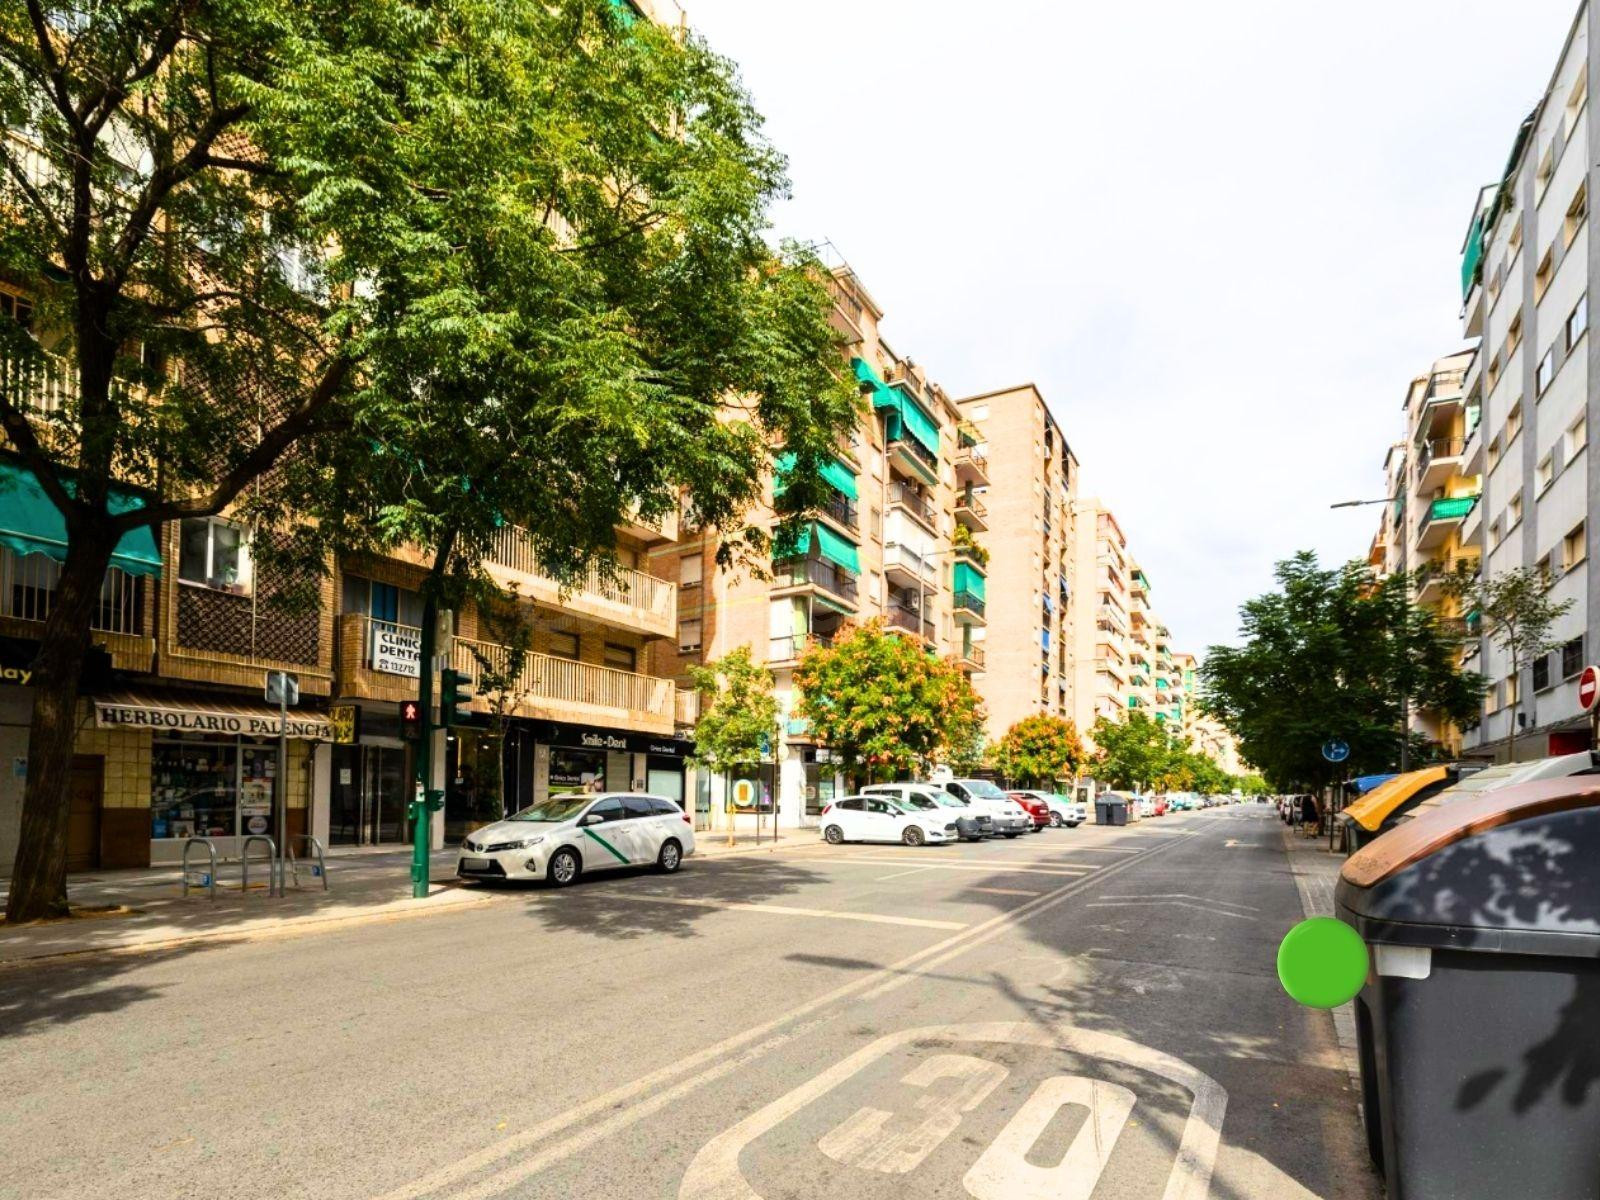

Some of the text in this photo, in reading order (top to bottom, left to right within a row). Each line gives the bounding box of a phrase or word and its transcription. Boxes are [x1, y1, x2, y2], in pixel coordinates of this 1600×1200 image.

[380, 644, 420, 661] DENTA
[381, 633, 420, 650] CLINIC
[101, 707, 241, 732] HERBOLARIO
[249, 722, 331, 738] PALENCIA
[817, 1054, 1137, 1200] 30
